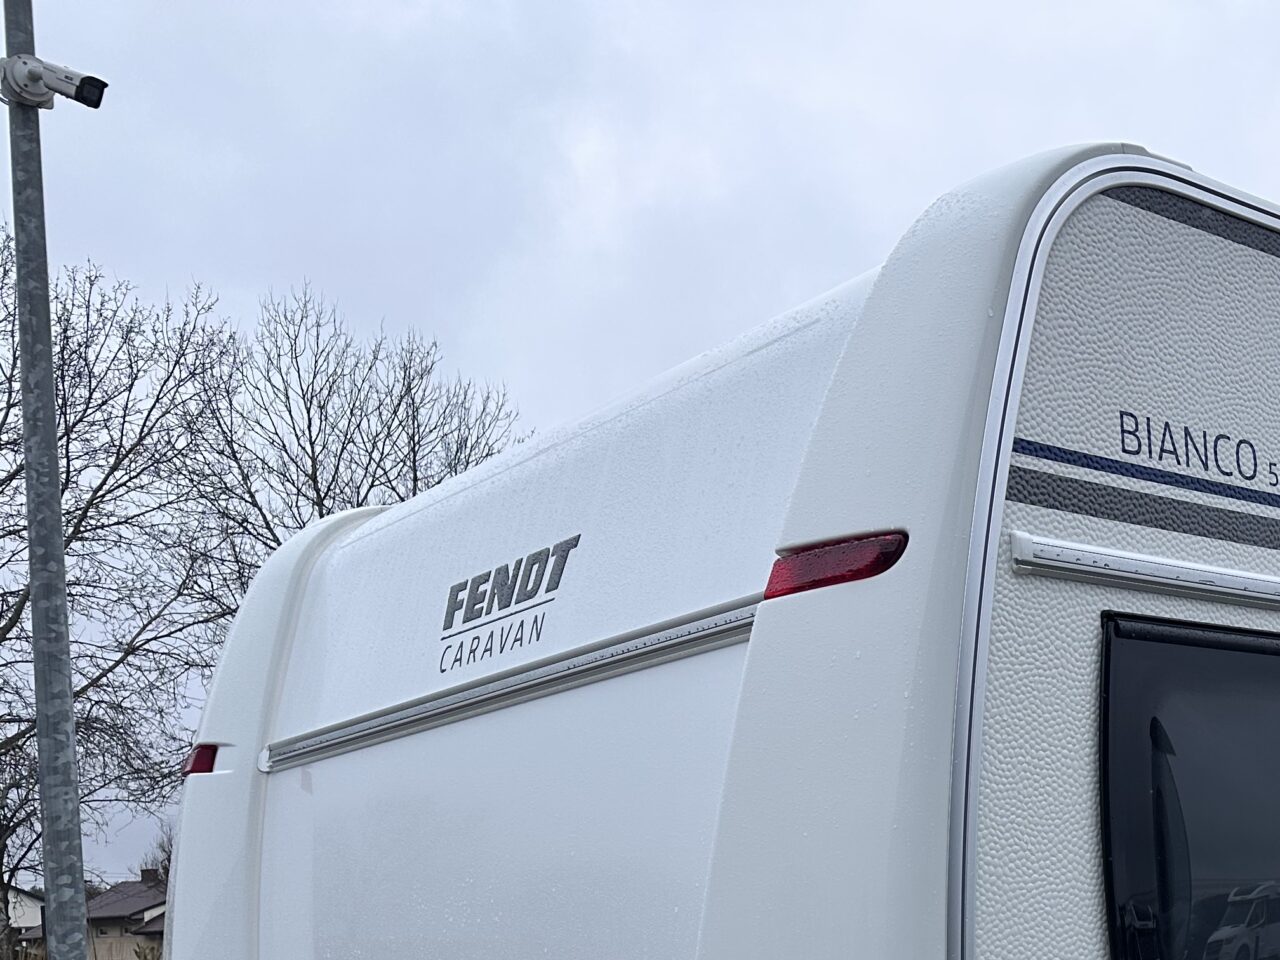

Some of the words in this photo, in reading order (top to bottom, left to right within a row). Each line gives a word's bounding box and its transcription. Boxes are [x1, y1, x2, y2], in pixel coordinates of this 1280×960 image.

[1118, 410, 1258, 481] BIANCO
[442, 533, 582, 631] FENDT
[439, 611, 546, 674] CARAVAN
